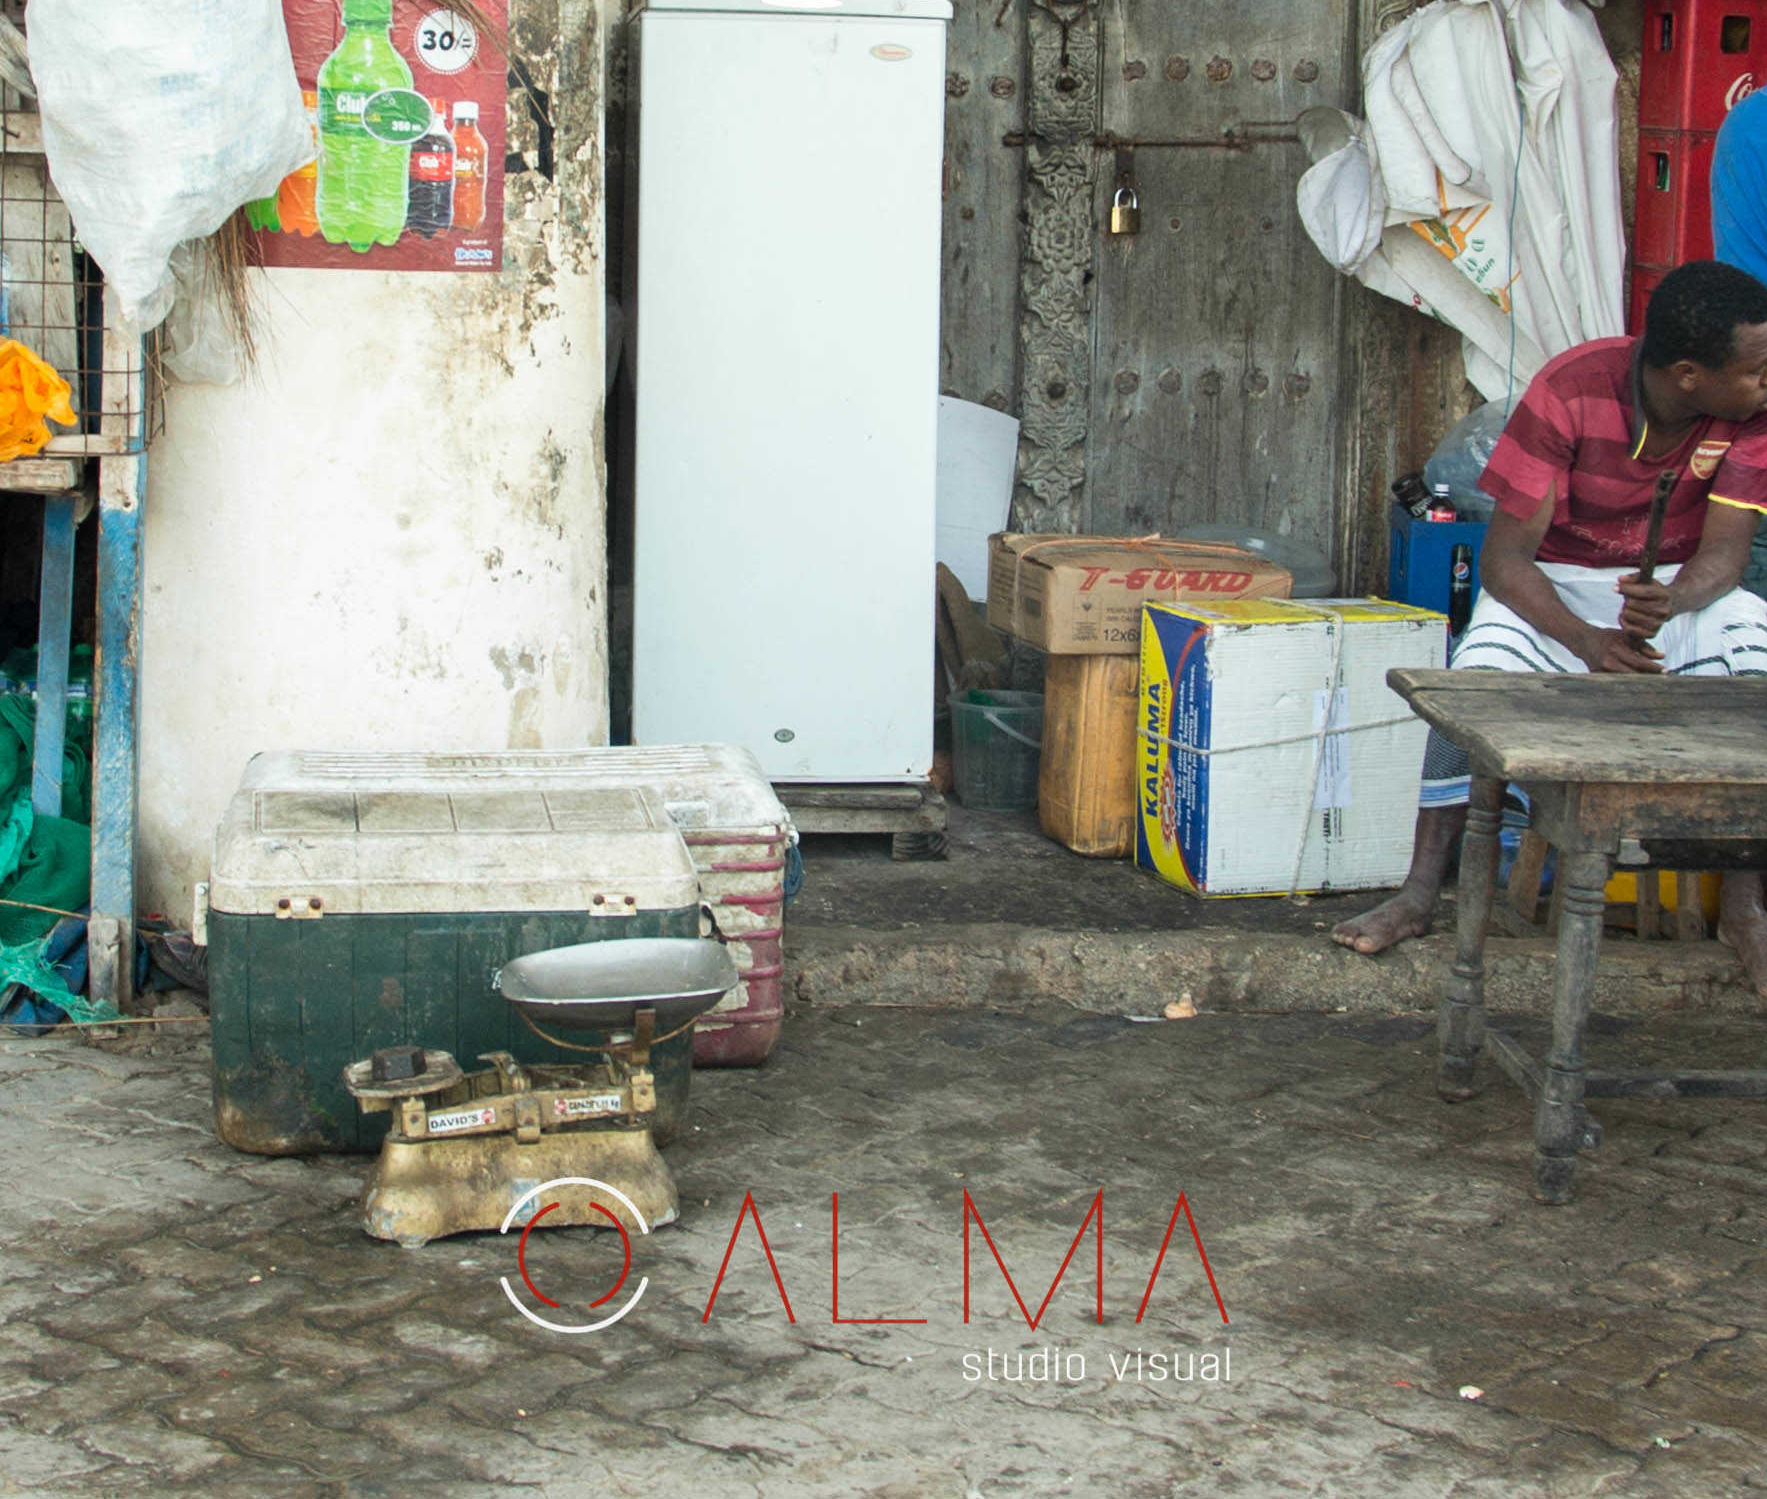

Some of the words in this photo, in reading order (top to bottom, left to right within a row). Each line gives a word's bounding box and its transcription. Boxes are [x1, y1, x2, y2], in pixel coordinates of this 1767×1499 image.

[1079, 566, 1253, 593] T-GUARD
[1145, 682, 1161, 819] KALUMA
[430, 1114, 479, 1129] DAVID'S
